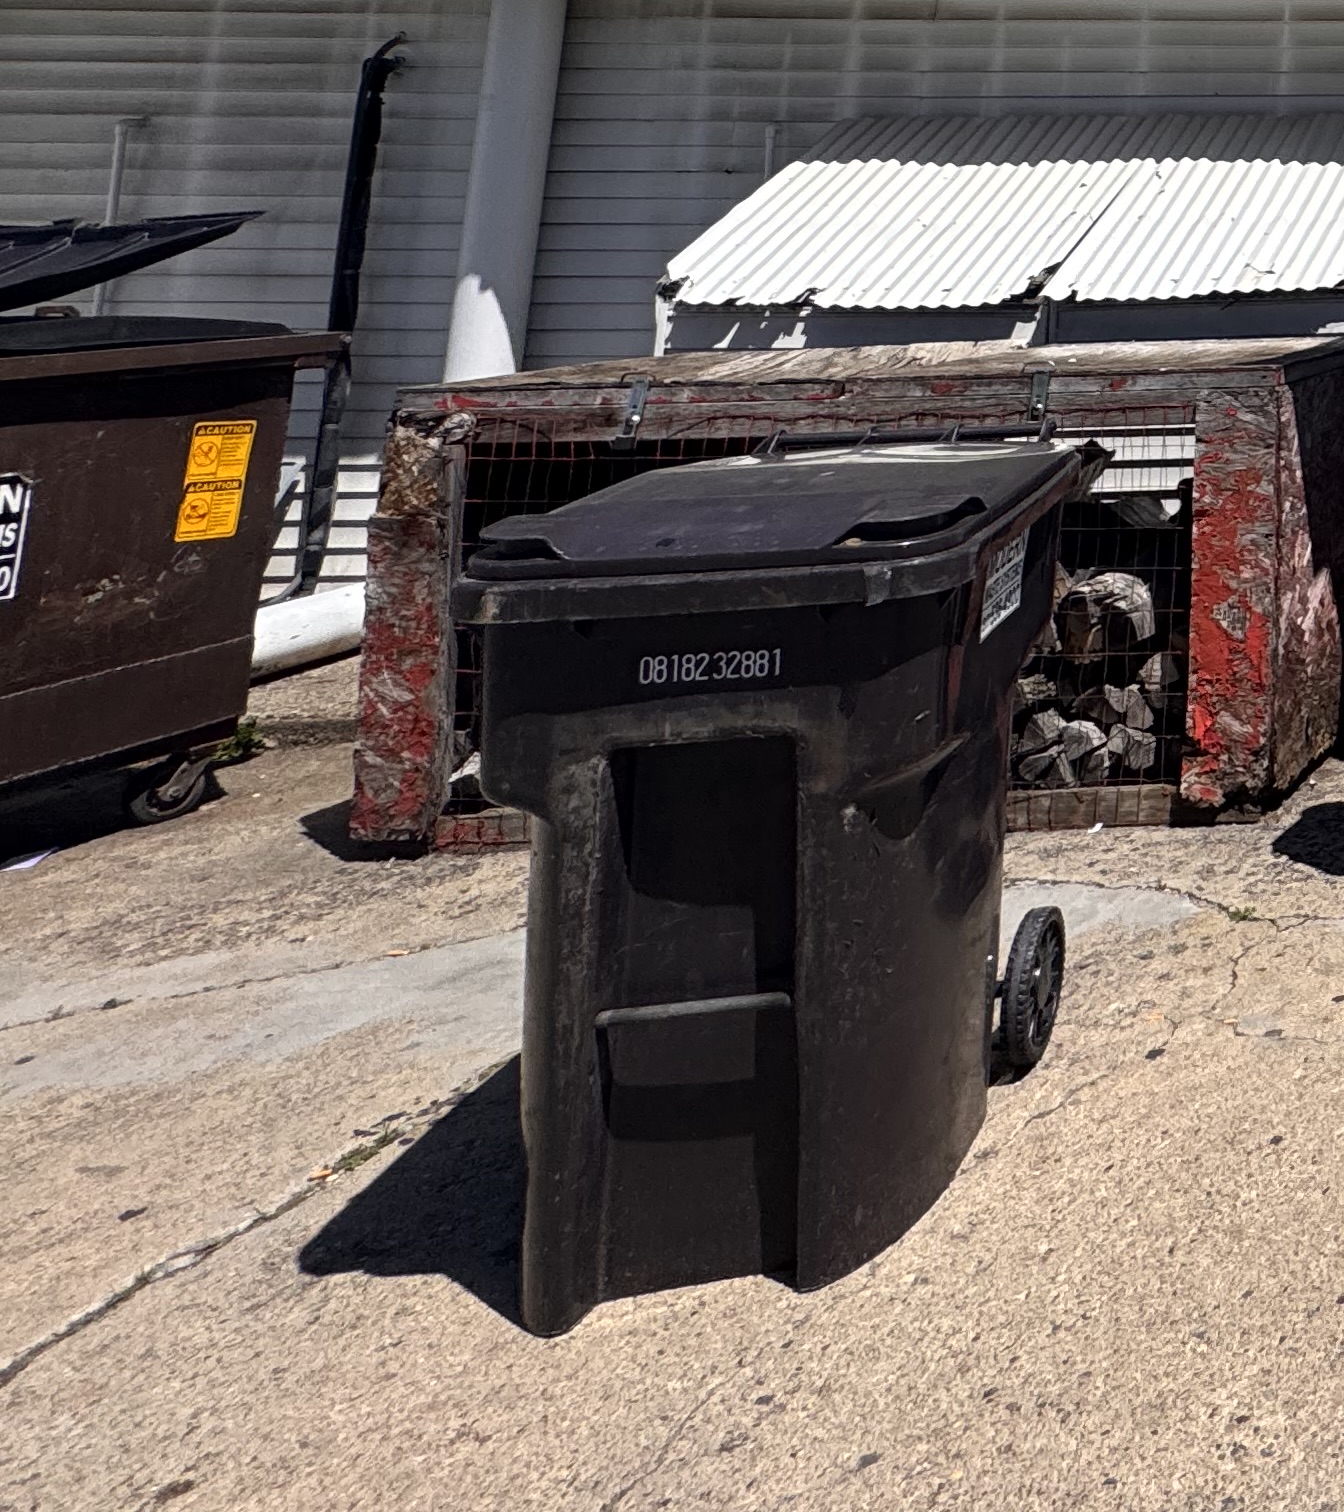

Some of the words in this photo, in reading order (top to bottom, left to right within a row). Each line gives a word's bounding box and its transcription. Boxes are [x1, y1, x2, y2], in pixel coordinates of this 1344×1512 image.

[207, 425, 252, 434] CAUTION
[196, 481, 240, 491] CAUTION
[639, 648, 781, 685] 0818232881
